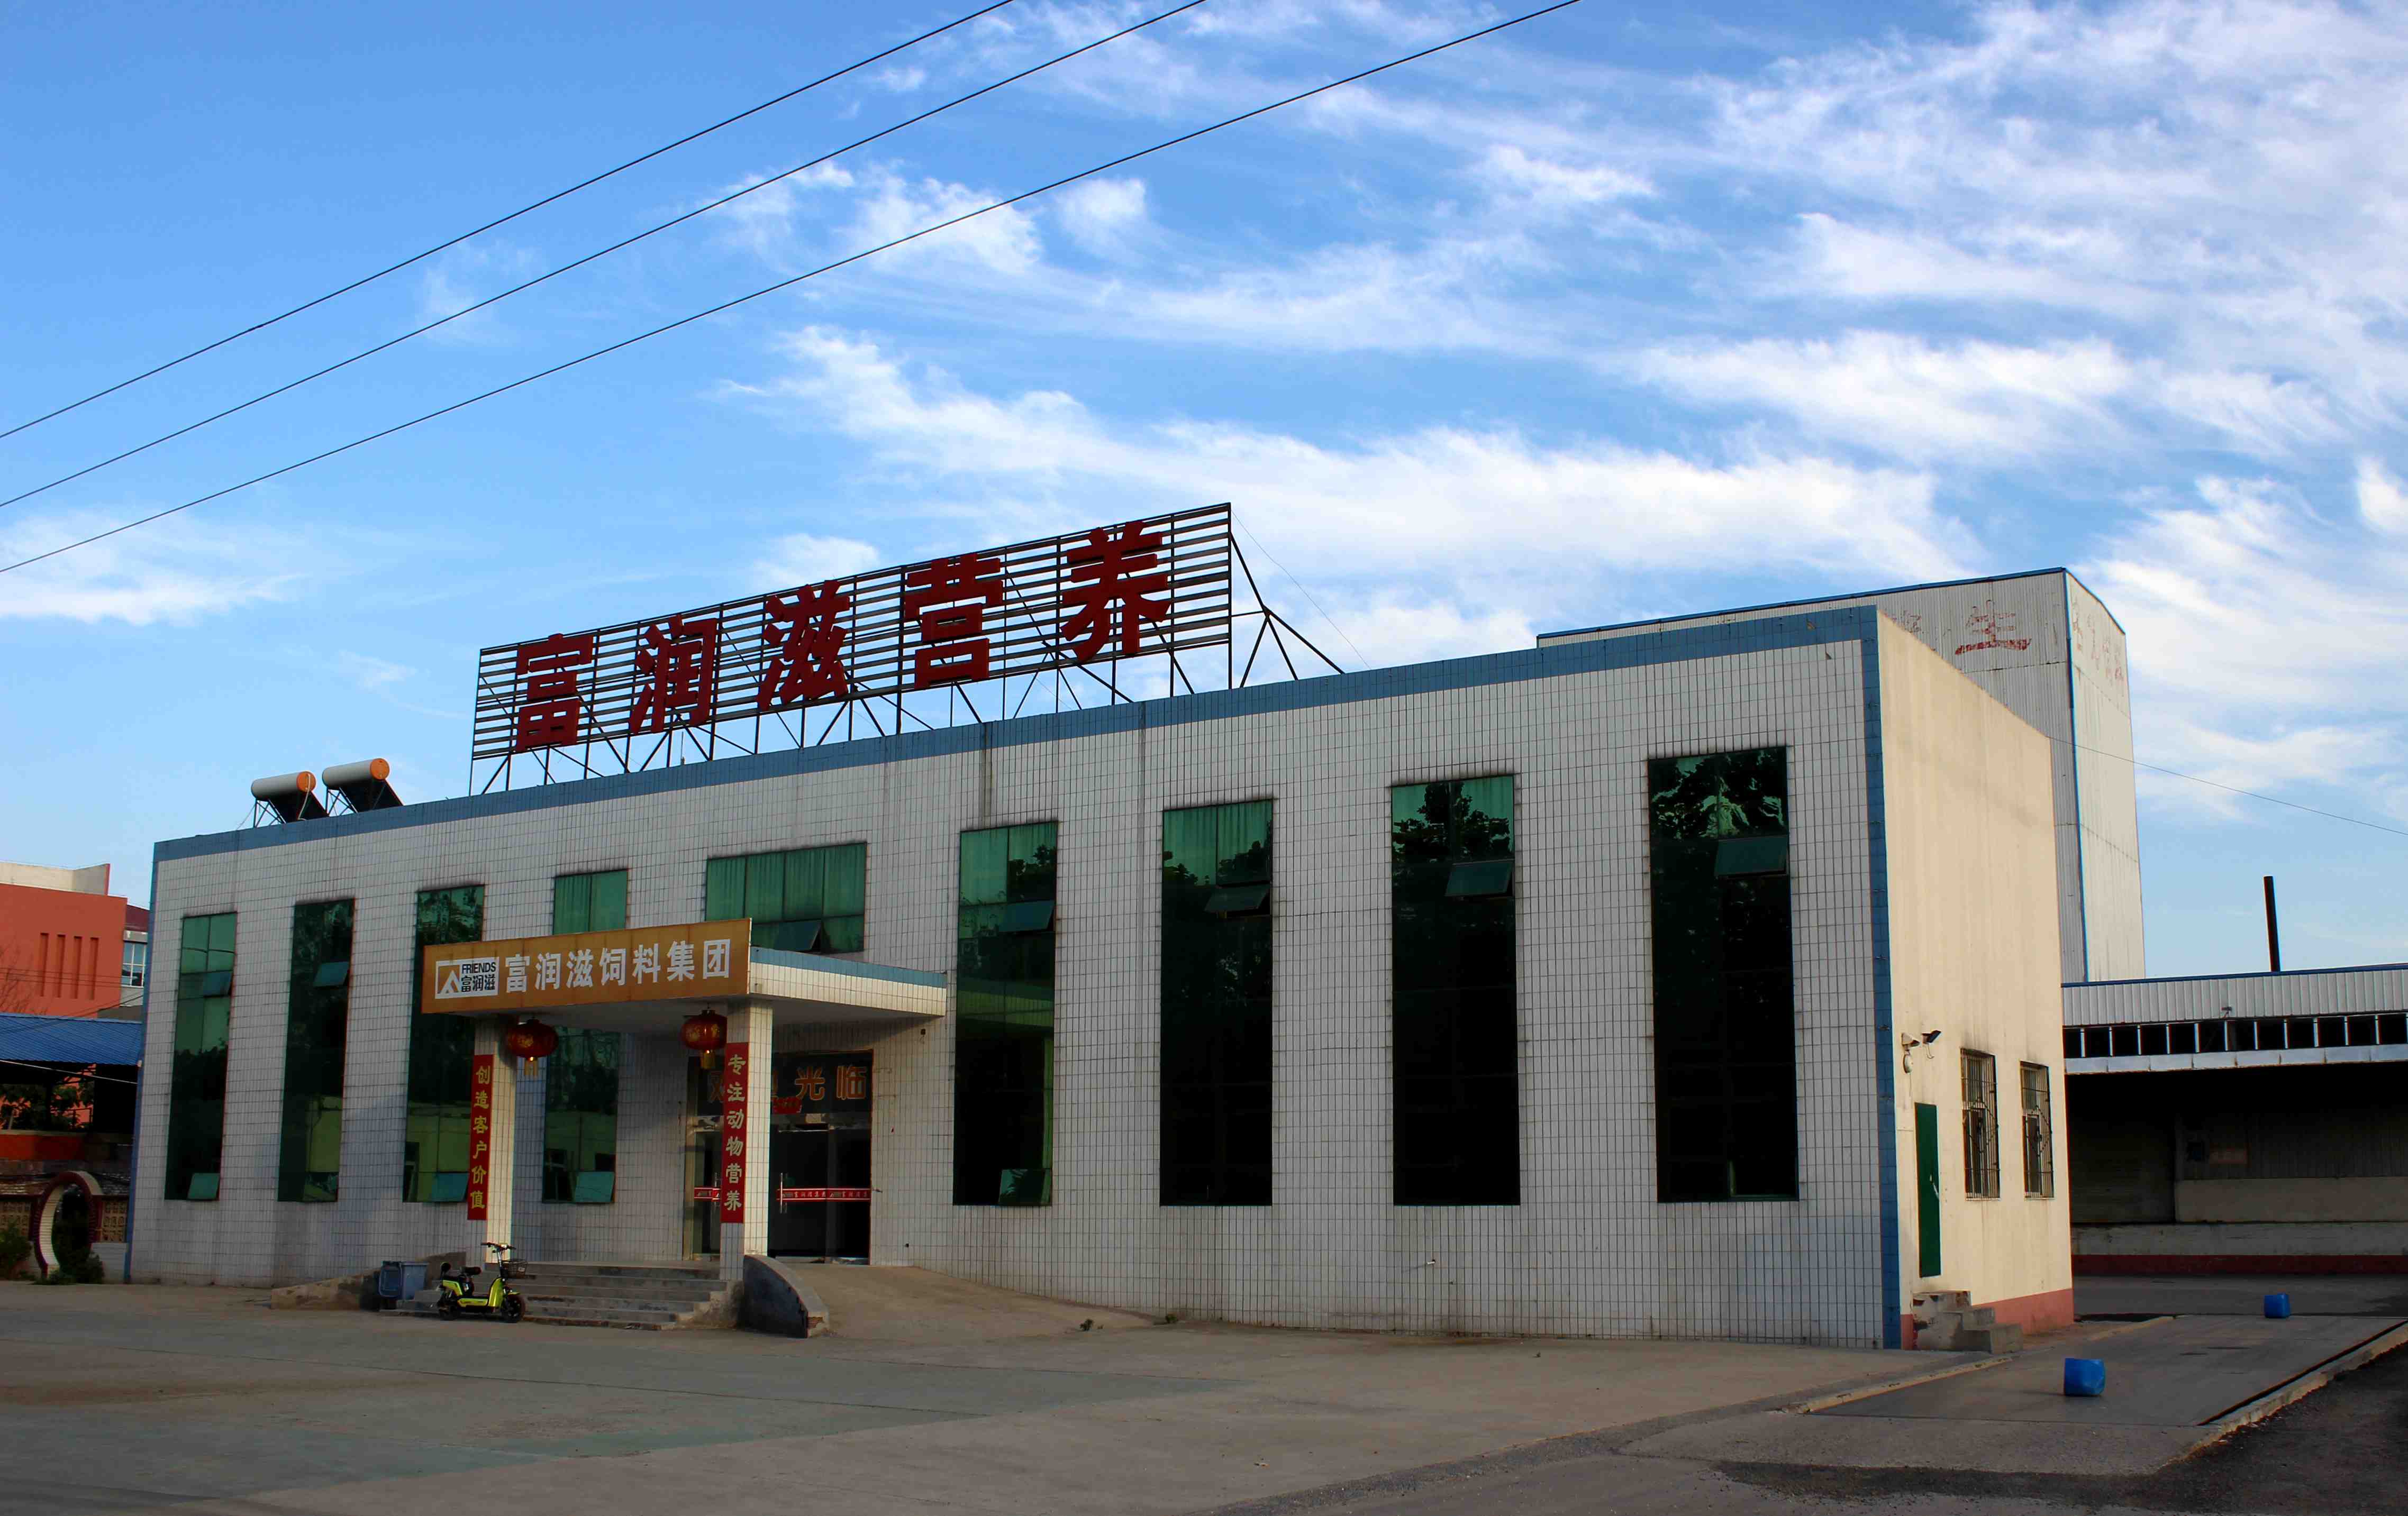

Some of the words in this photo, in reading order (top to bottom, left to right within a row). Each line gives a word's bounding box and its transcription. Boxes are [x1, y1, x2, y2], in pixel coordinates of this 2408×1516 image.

[515, 520, 1171, 752] 富润滋营养
[461, 974, 496, 992] 富润滋
[462, 962, 496, 974] FRIENDS
[505, 939, 731, 993] 富润滋饲料集团
[470, 1066, 490, 1209] 创造客户价值
[725, 1054, 746, 1211] 专注动物营养
